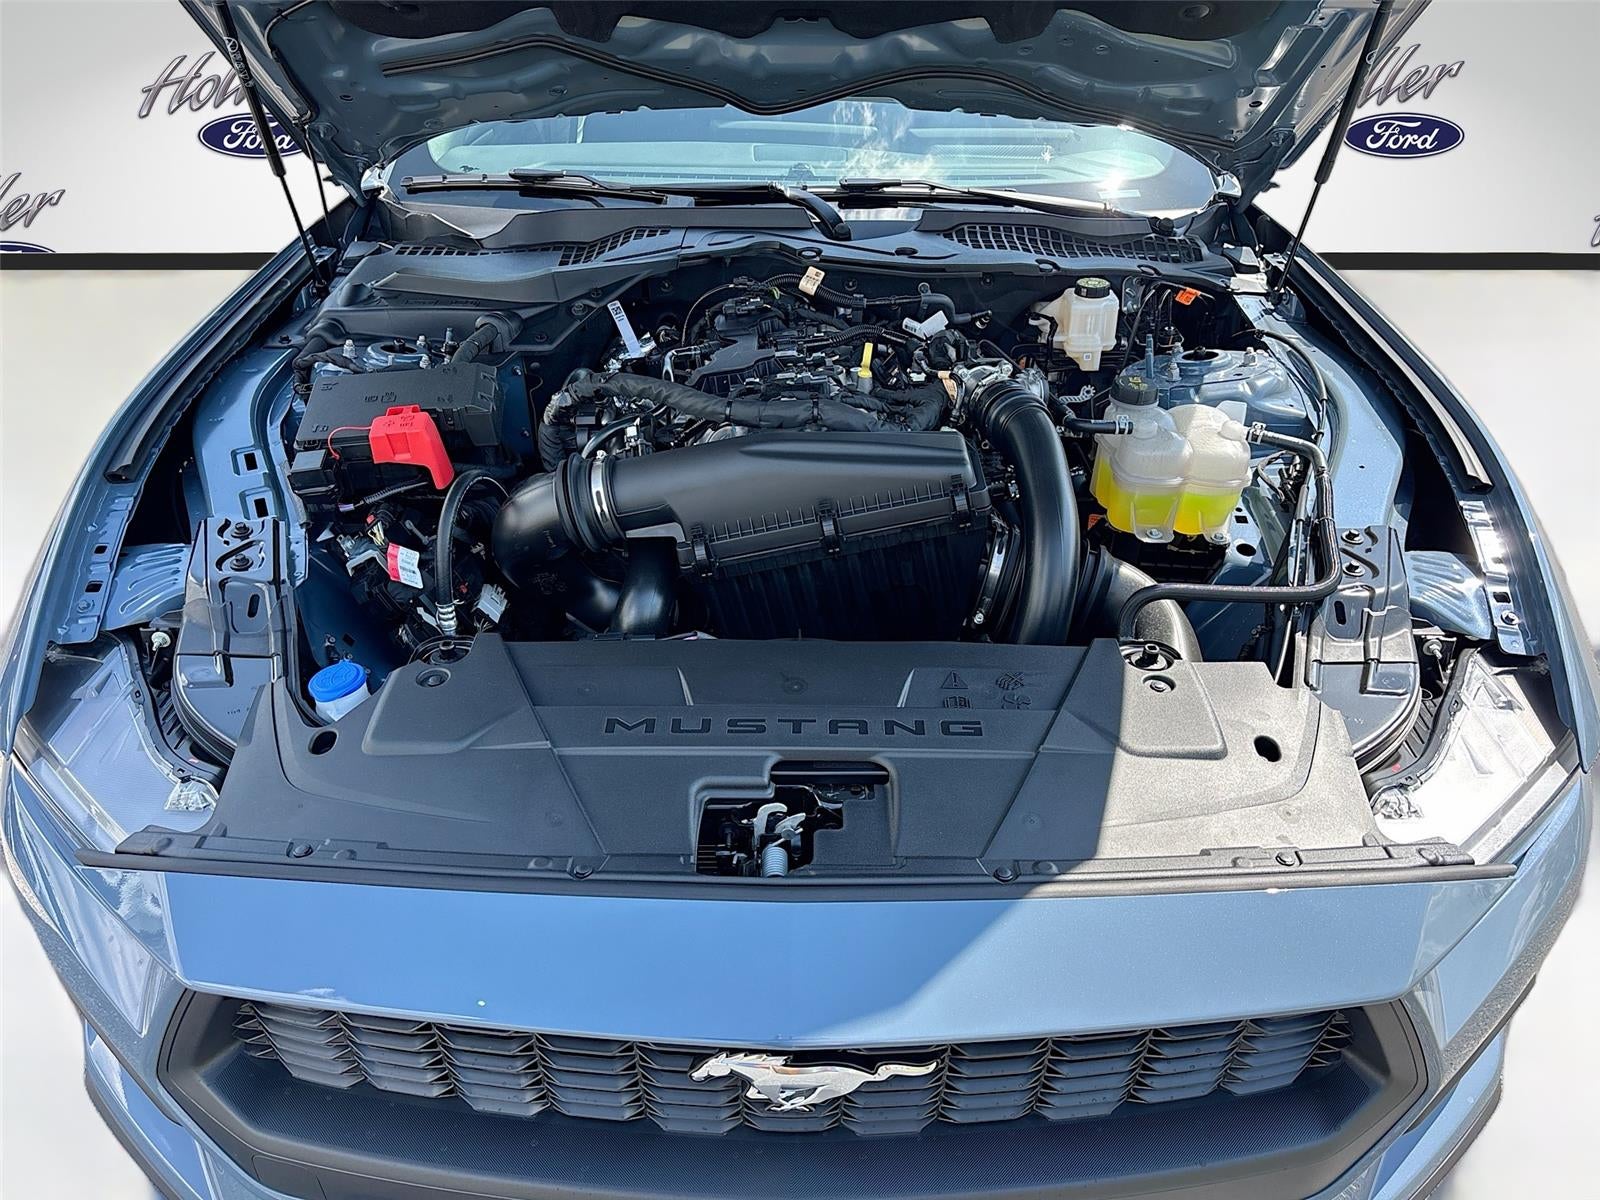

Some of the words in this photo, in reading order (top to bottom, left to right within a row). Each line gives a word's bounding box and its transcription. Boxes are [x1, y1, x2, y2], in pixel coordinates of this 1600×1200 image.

[1357, 43, 1464, 109] ller
[223, 119, 295, 149] Fod
[1365, 119, 1440, 149] Ford
[604, 716, 984, 737] MUSTANG
